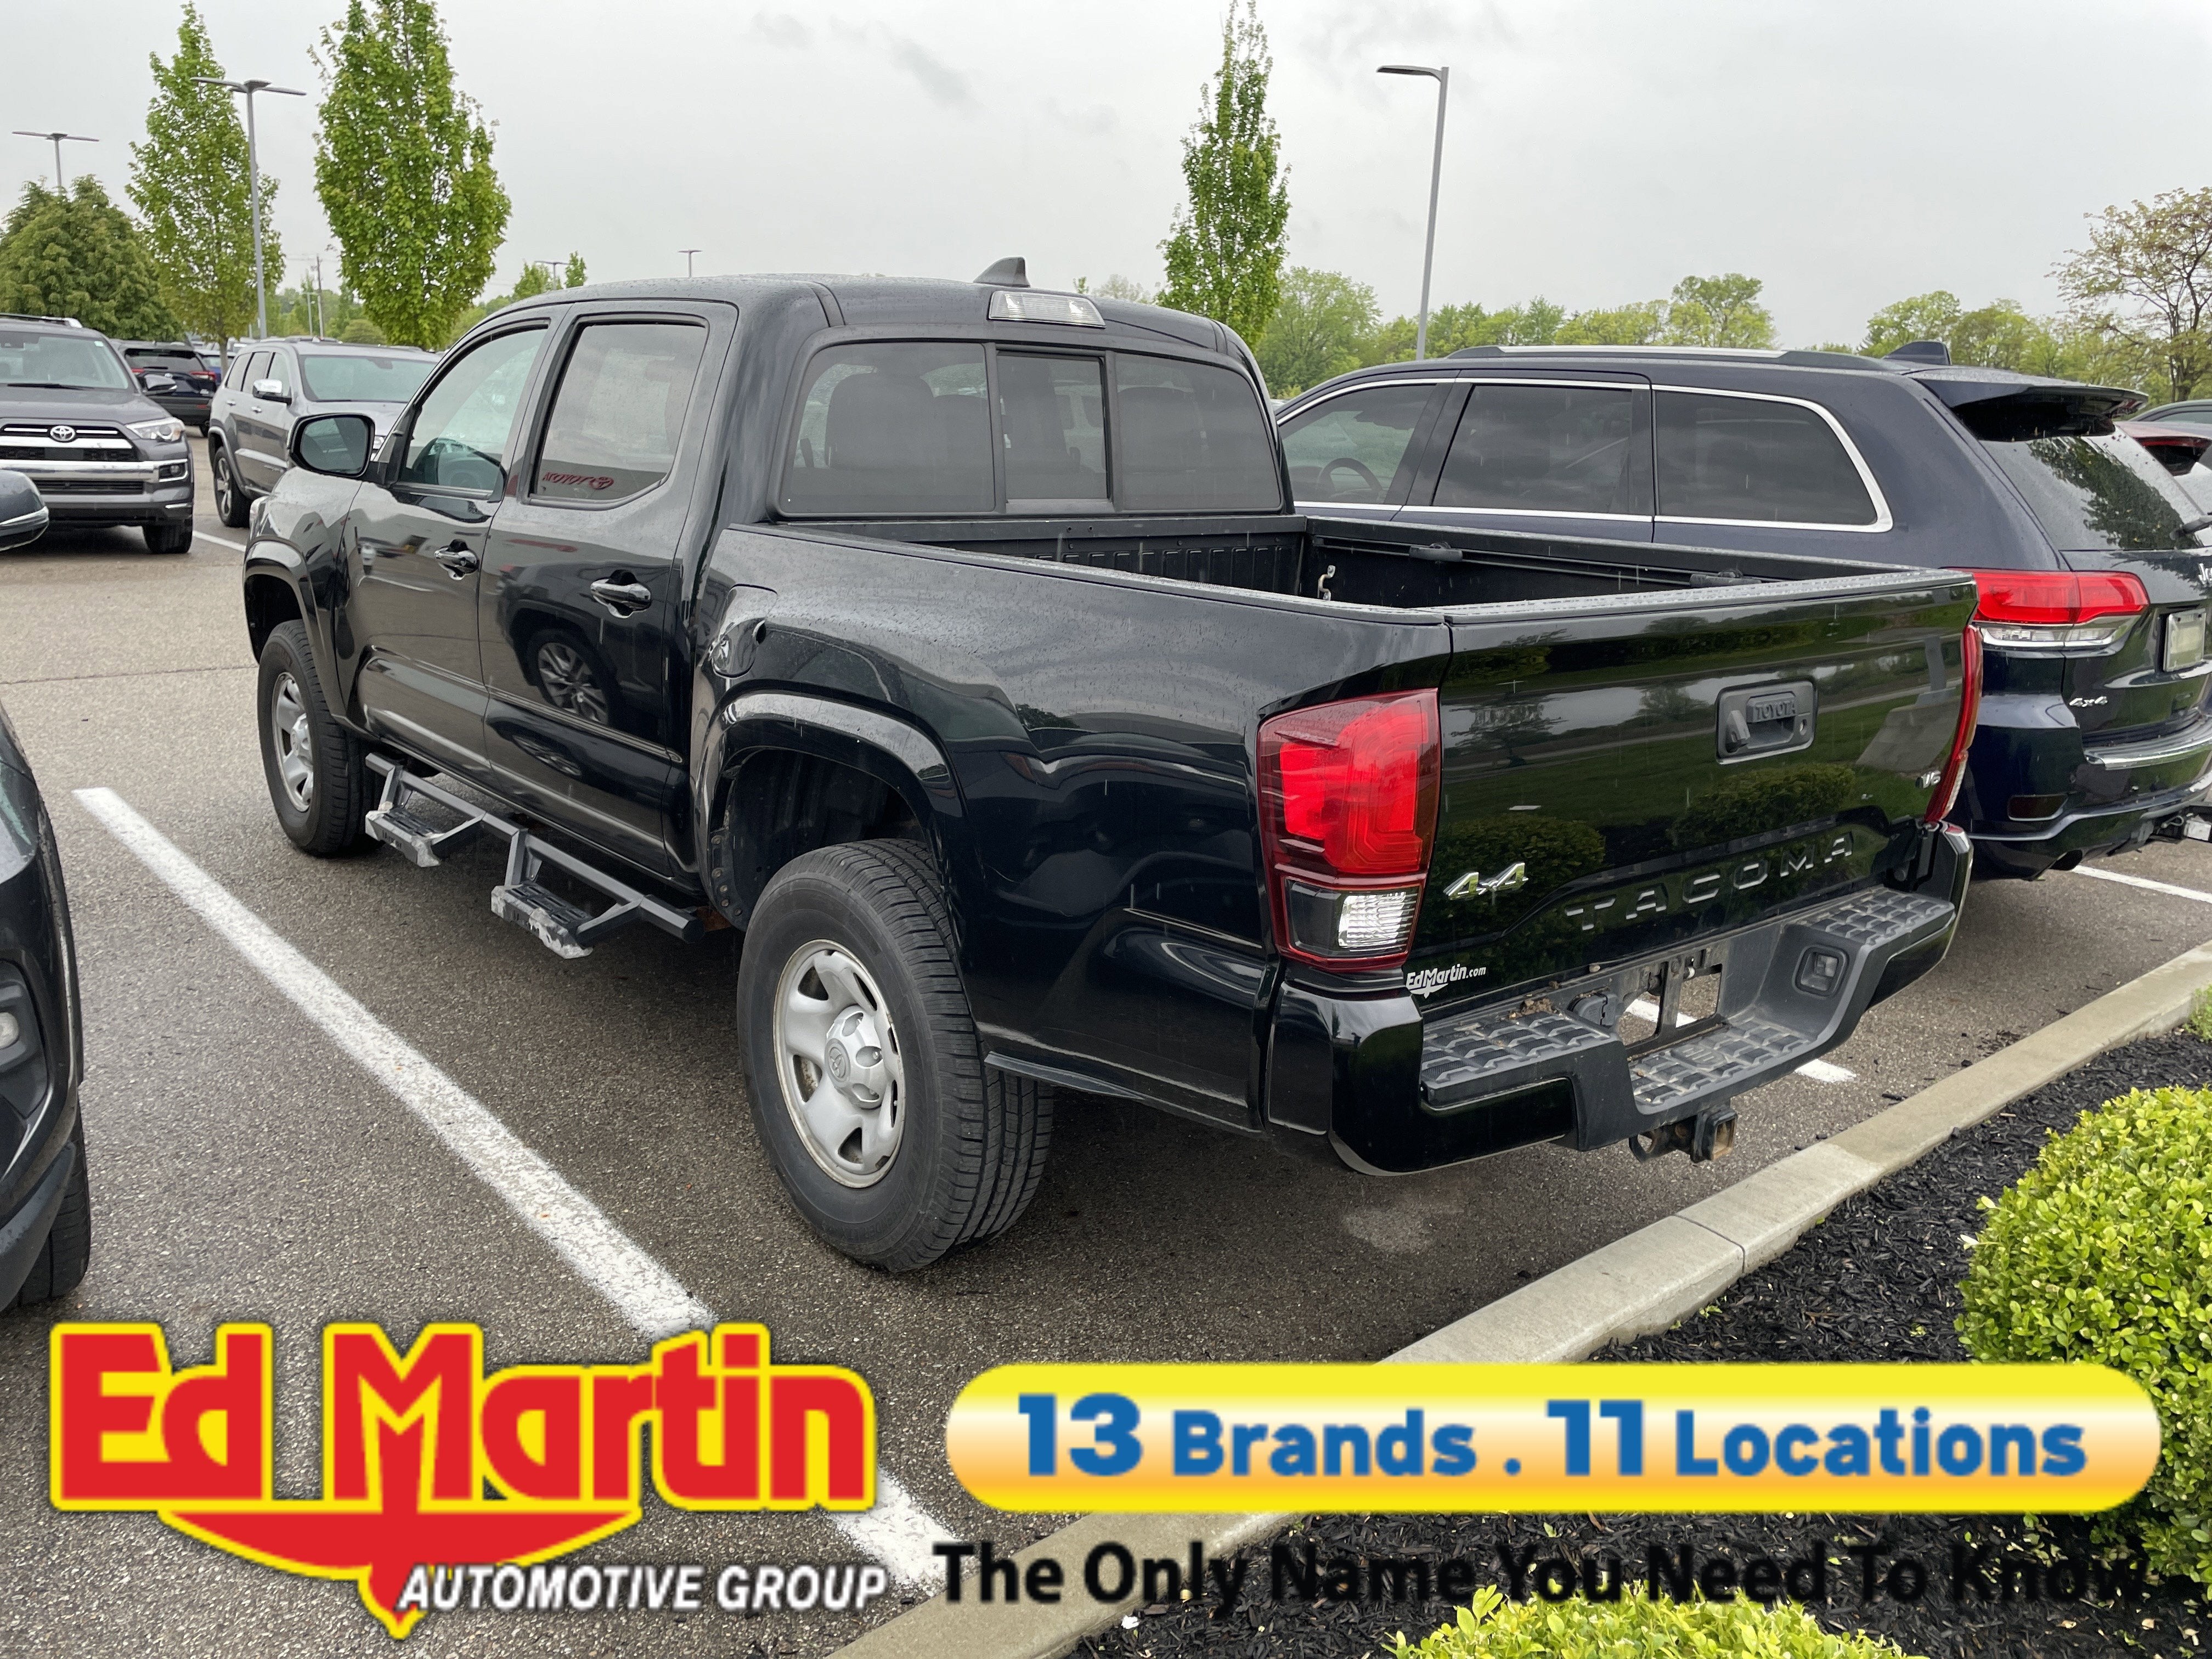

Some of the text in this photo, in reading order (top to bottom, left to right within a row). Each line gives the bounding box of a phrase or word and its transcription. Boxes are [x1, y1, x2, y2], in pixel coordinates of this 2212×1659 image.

[1753, 701, 1797, 720] TOYOTA
[2068, 696, 2108, 708] 4x4
[1920, 769, 1942, 789] V6
[1443, 862, 1530, 901] 4x4
[1565, 831, 1854, 932] TACOMA
[1406, 963, 1487, 992] EdMartin.com
